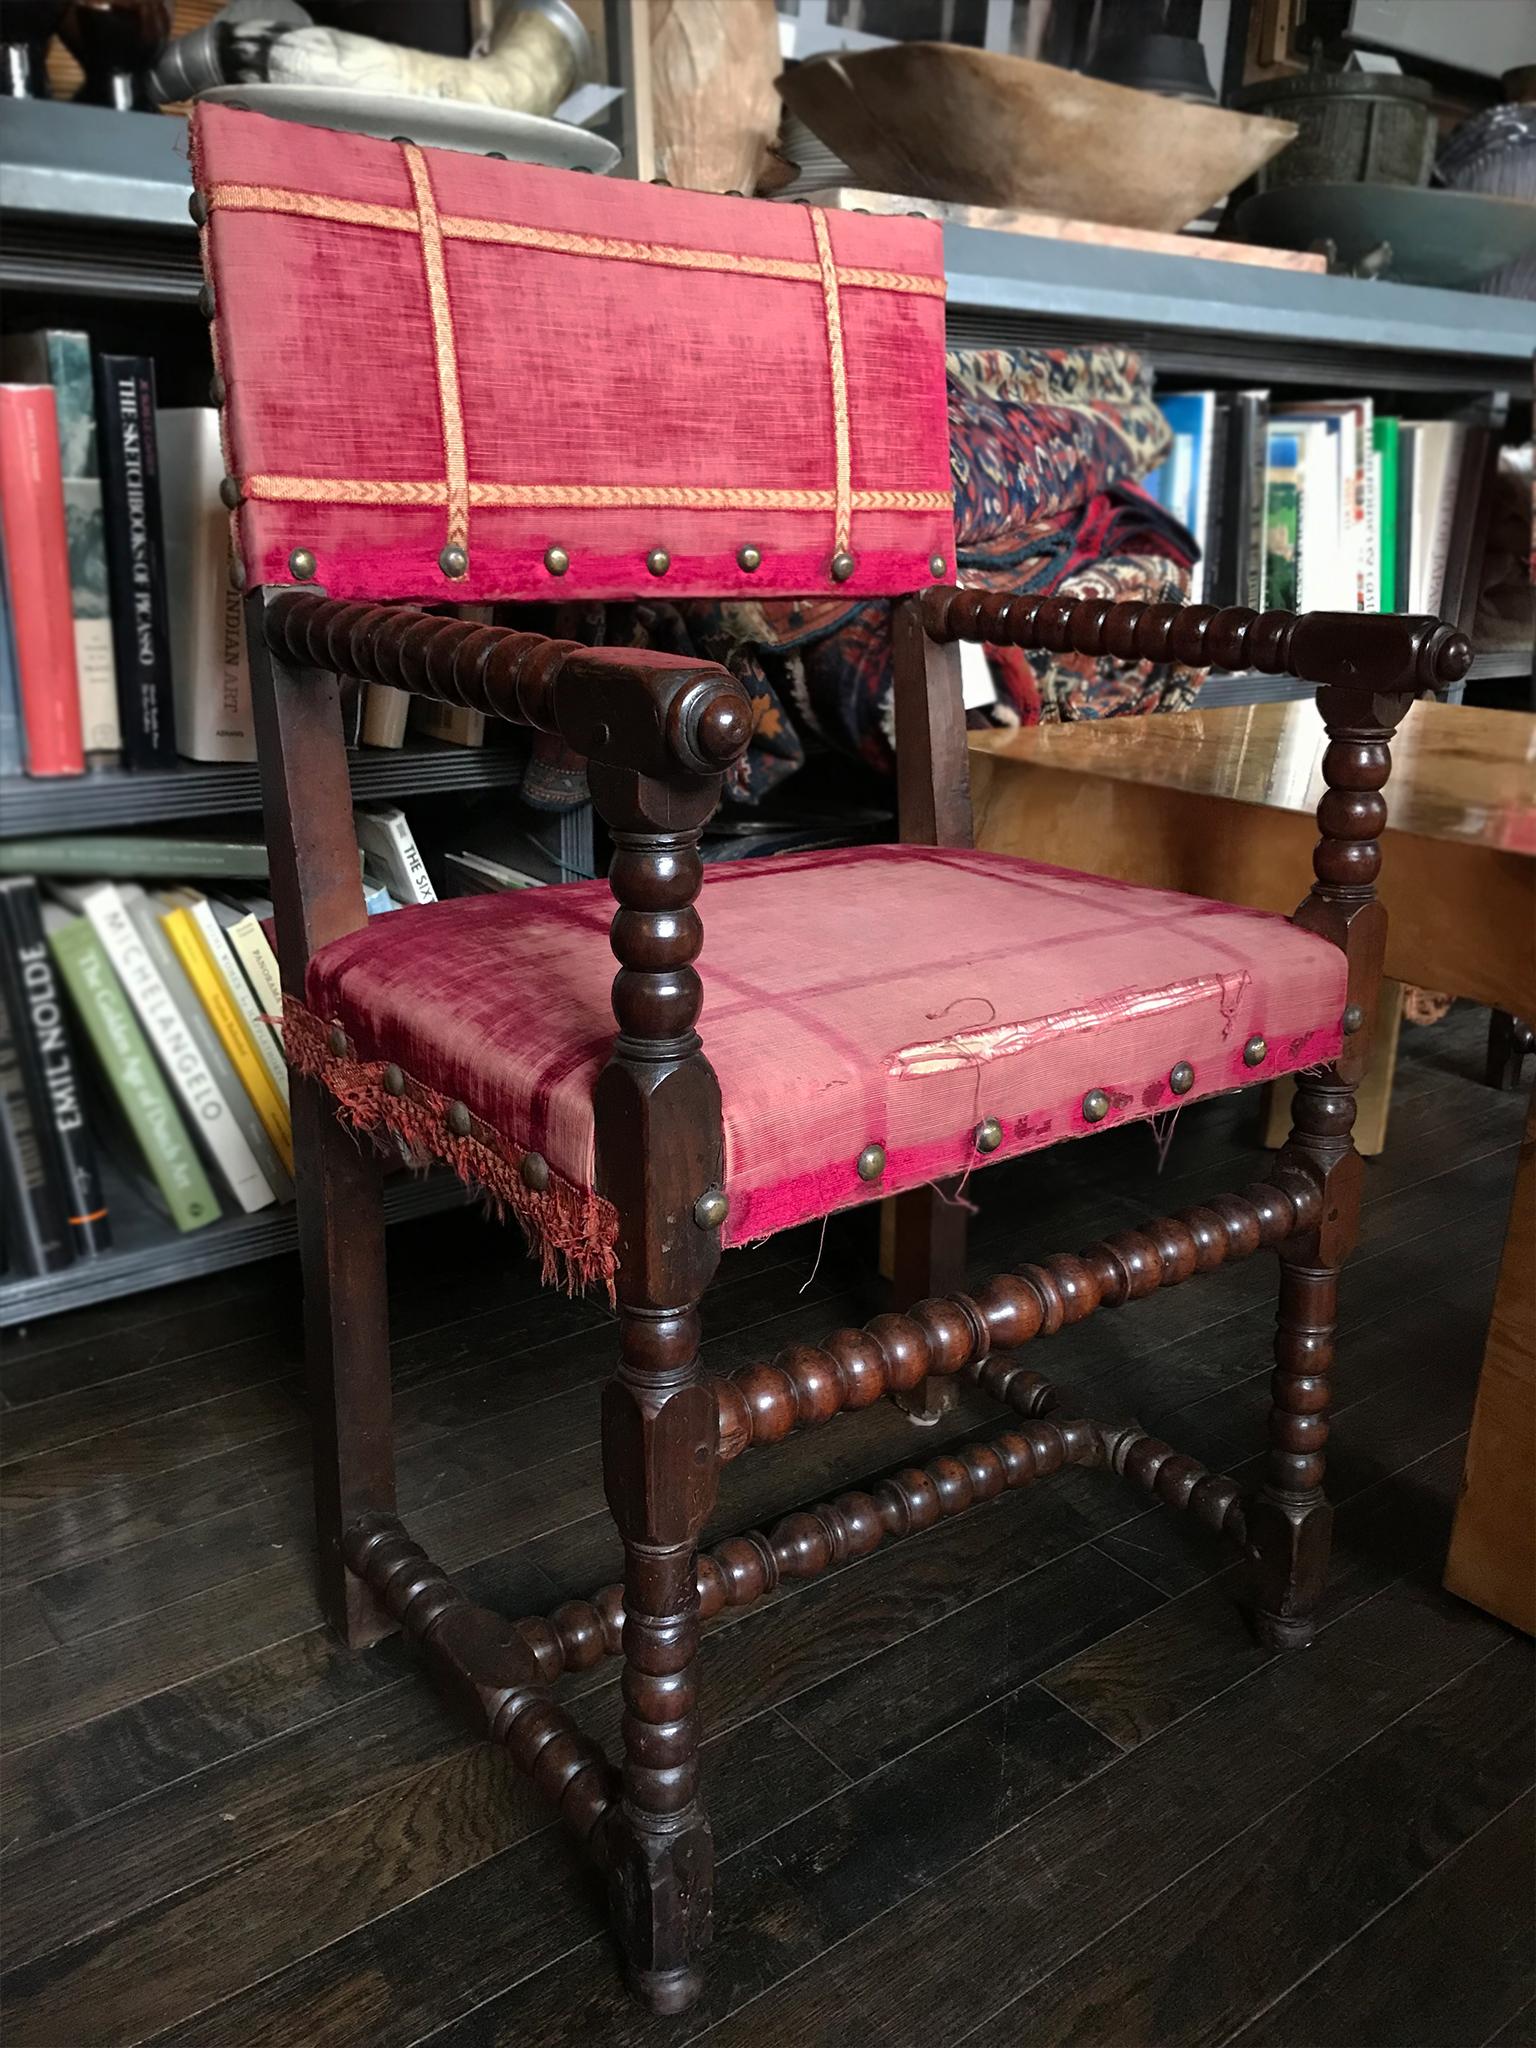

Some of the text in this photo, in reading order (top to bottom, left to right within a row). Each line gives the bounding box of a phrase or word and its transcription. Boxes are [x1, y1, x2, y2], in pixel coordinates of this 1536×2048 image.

[118, 376, 138, 420] THE
[122, 422, 147, 561] SKETCHBOOKS
[132, 562, 149, 584] OF
[1426, 553, 1445, 613] JAPAN
[134, 591, 155, 666] PICASSO
[224, 590, 241, 713] INDIAN ART
[404, 844, 422, 873] THE
[18, 942, 66, 1053] NOLDE
[252, 948, 281, 1003] PANORAMA
[104, 911, 222, 1121] MICHELANGELO
[44, 1055, 83, 1133] EMIL
[77, 951, 196, 1190] The Golden Age of Dutch Art
